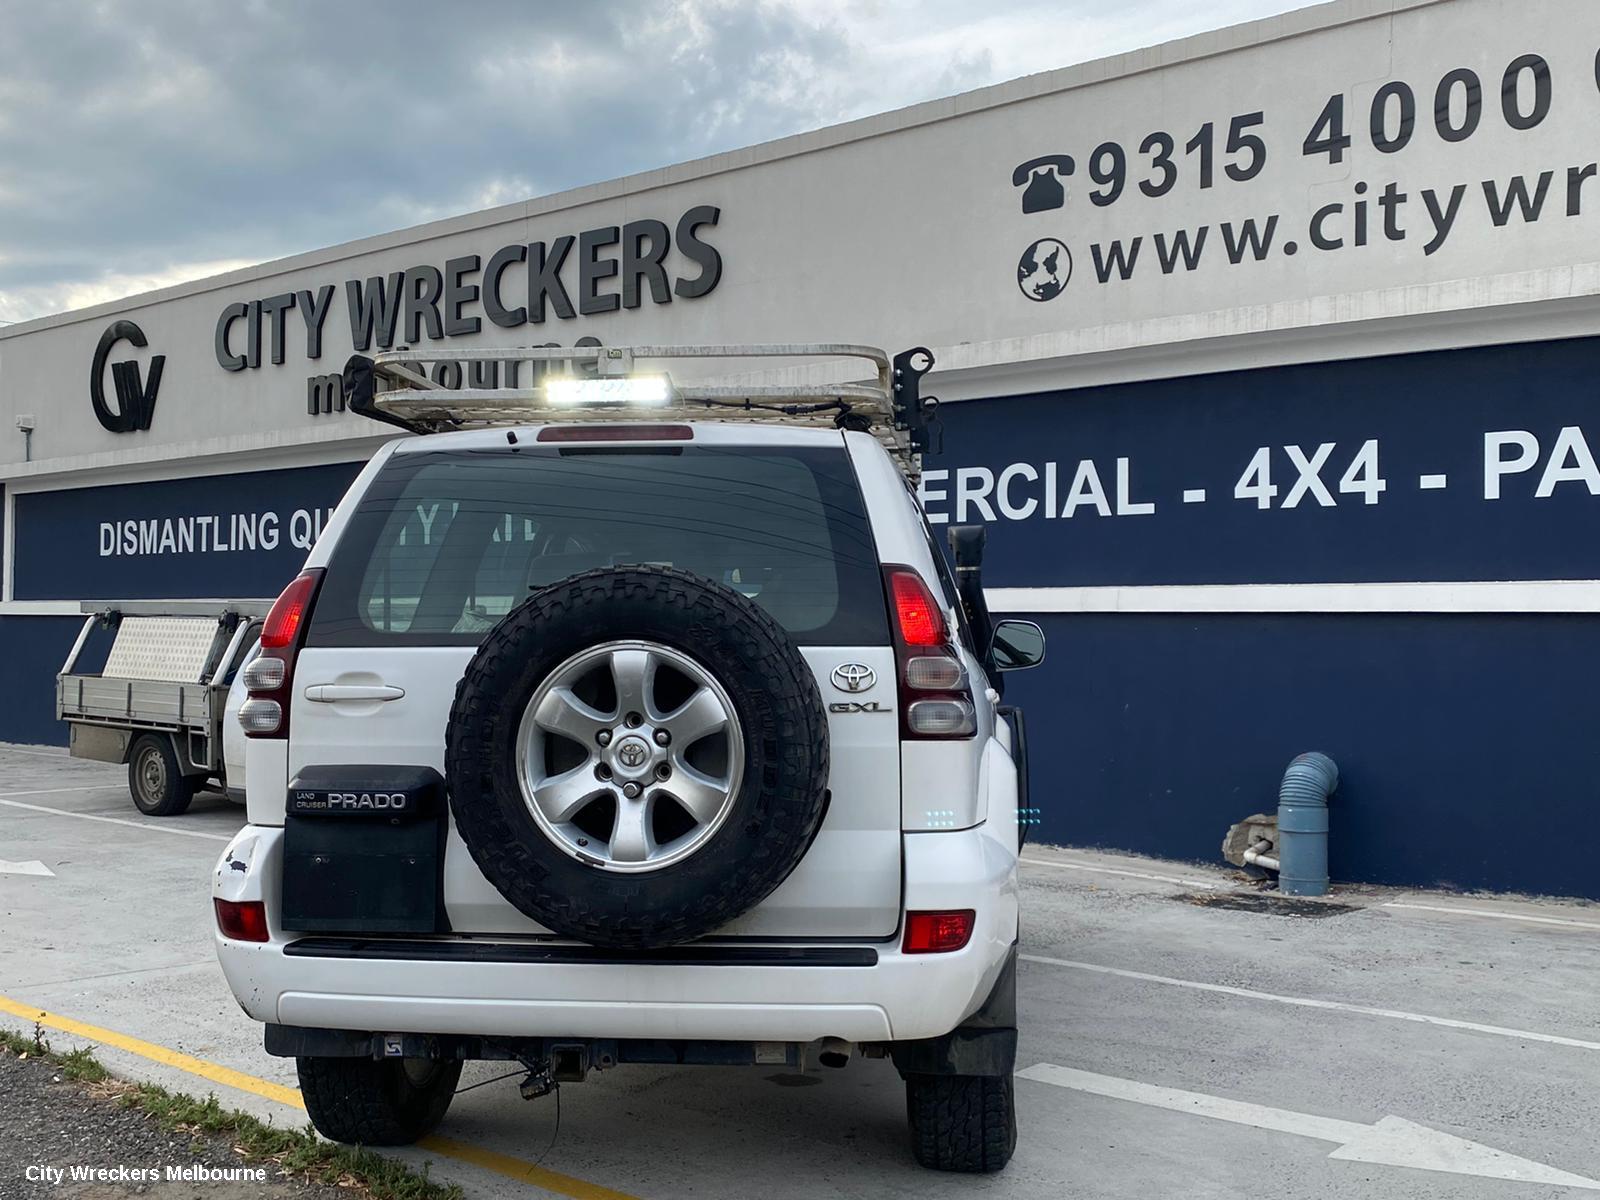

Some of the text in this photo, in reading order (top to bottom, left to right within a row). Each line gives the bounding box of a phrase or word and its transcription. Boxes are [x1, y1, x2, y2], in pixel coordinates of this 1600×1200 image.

[1087, 111, 1267, 207] 9315
[1302, 53, 1552, 164] 4000
[215, 205, 722, 372] CITY WRECKERS
[918, 457, 1155, 524] ERCIAL
[1233, 439, 1386, 510] 4X4
[99, 511, 279, 556] DISMANTLING
[828, 702, 893, 713] GXL
[296, 792, 315, 800] LAND
[296, 793, 406, 809] CRUISER PRADO
